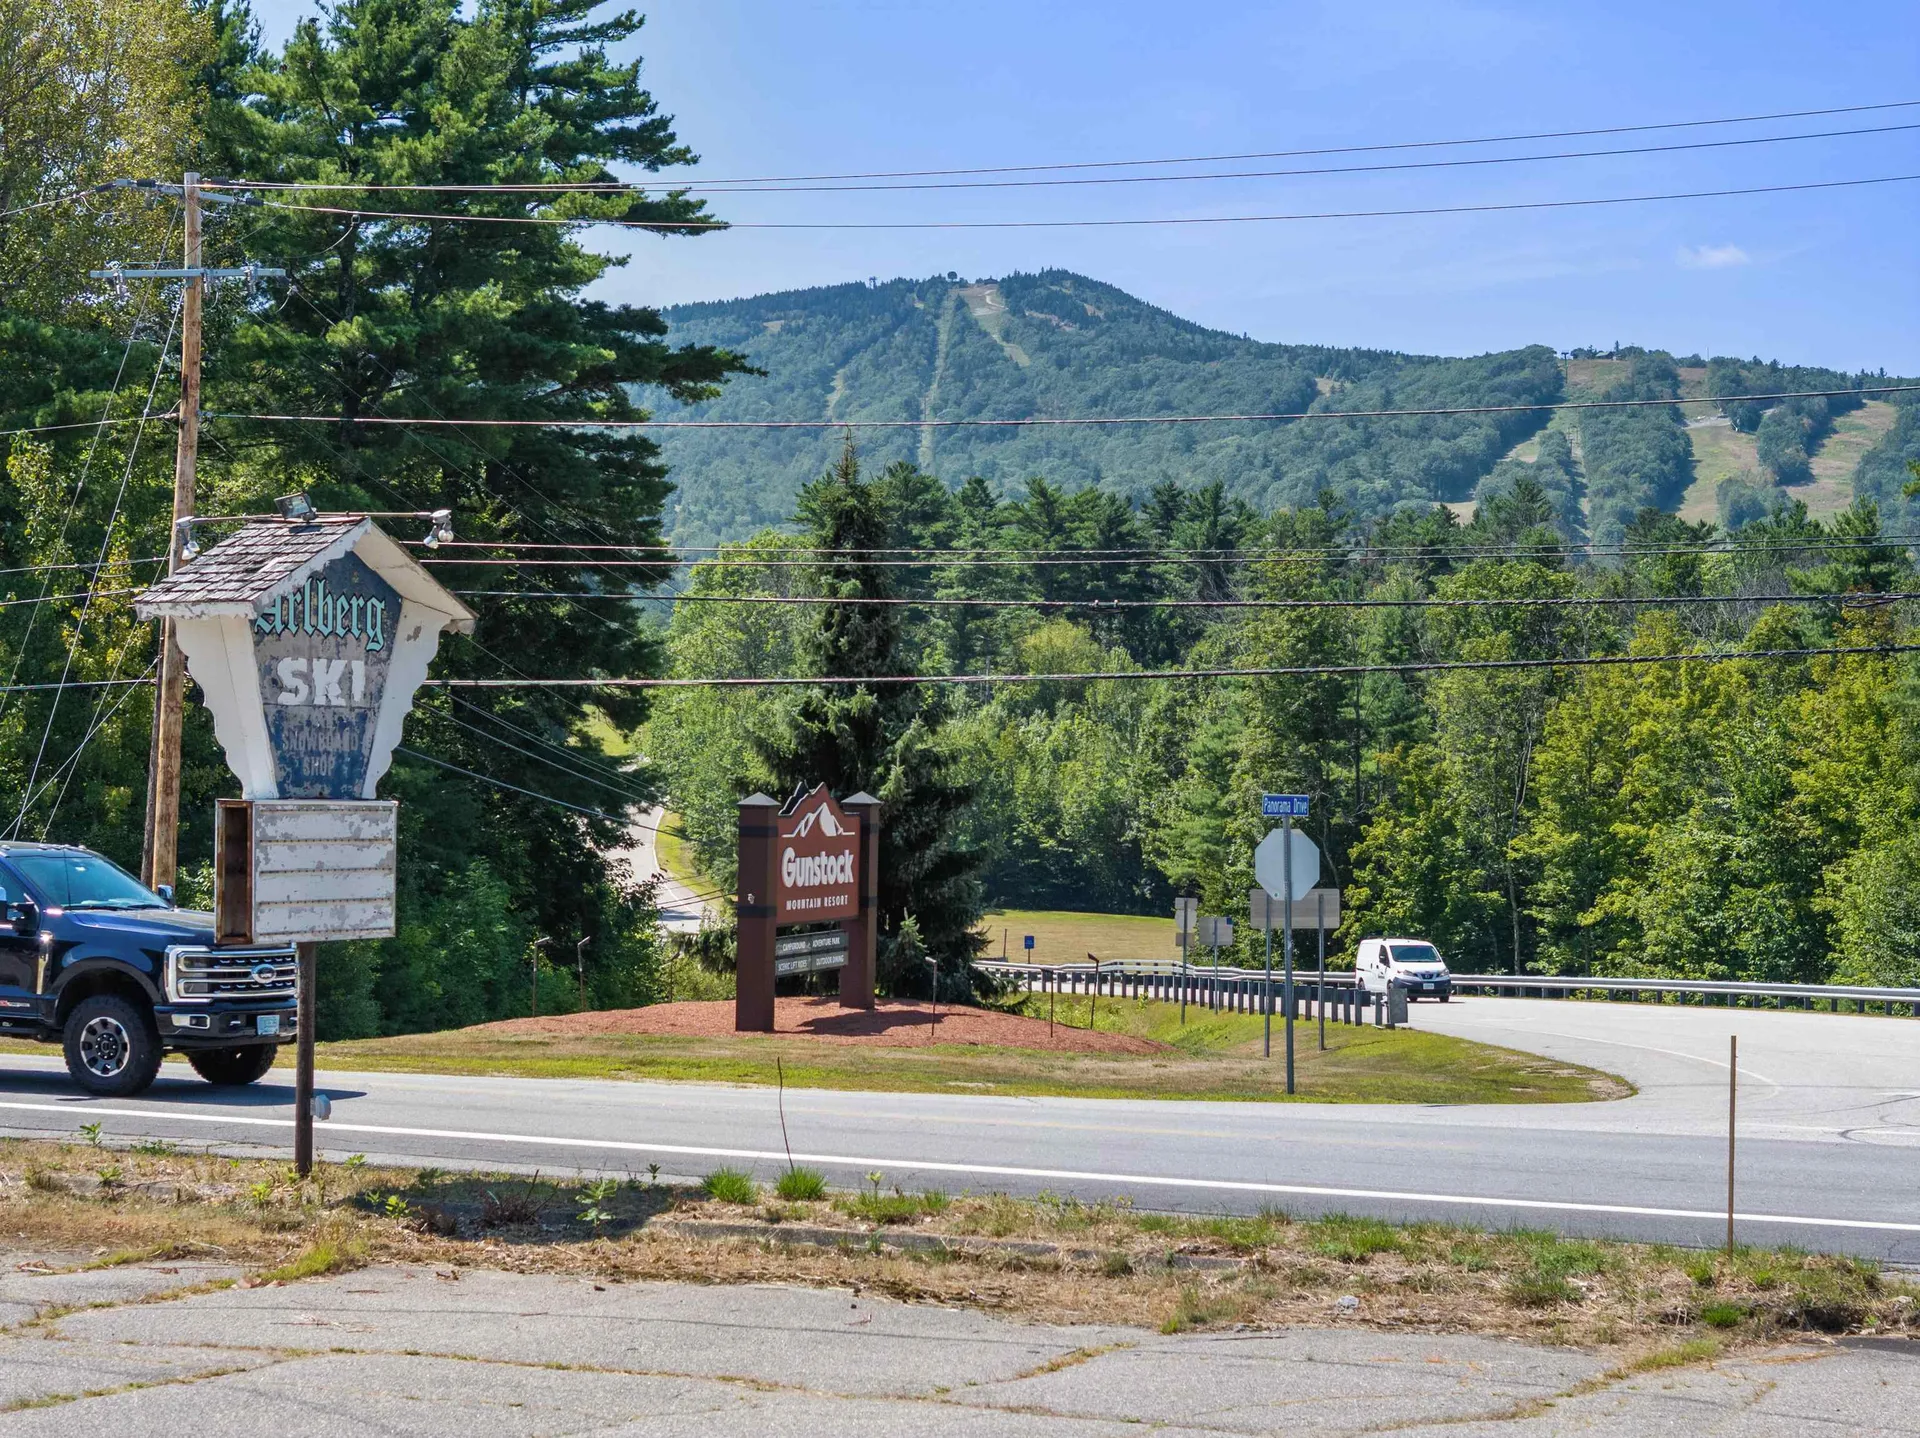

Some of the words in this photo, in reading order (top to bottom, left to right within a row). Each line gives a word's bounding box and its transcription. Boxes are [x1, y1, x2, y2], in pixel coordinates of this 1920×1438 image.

[277, 657, 365, 706] SKI
[303, 755, 336, 777] SHOP
[1264, 797, 1291, 813] Panorama
[1293, 797, 1307, 813] Drive
[781, 847, 854, 888] Gunstock
[786, 898, 821, 910] MOUNTAIN
[824, 894, 848, 907] RESORT
